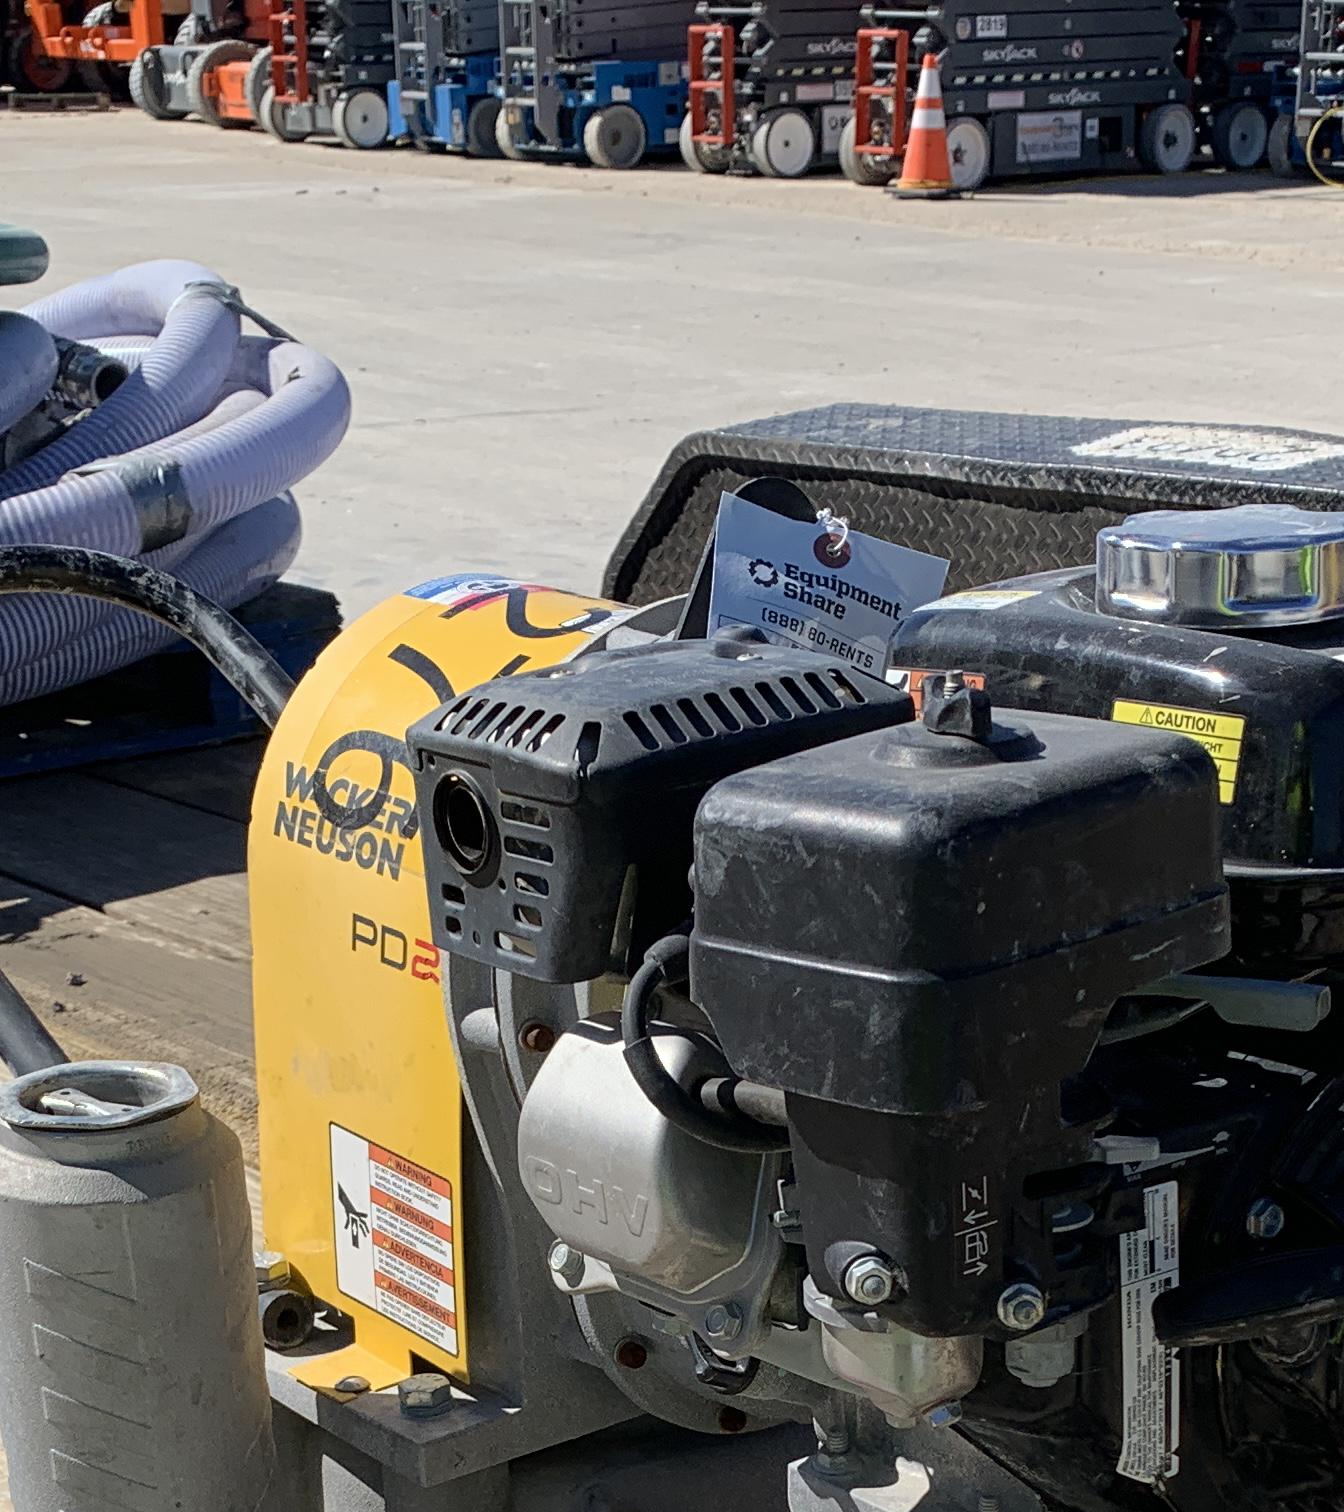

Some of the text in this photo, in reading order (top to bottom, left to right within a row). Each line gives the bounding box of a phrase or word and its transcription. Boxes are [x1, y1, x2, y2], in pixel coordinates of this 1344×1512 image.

[983, 44, 1037, 61] SKYJACK
[1048, 88, 1101, 104] SKYJACK
[782, 579, 846, 621] Share
[783, 562, 902, 624] Equipment
[761, 606, 805, 638] (888)
[808, 626, 874, 669] 80-RENTS
[1155, 709, 1217, 733] CAUTION
[283, 760, 420, 839] WACKER
[273, 800, 406, 881] NEUSON
[394, 1158, 432, 1187] WARNING
[393, 1200, 434, 1231] WARNUNG
[524, 1154, 649, 1238] OHV
[389, 1239, 443, 1280] ADVERTENCIA
[387, 1277, 450, 1325] AVERTISSEMENT
